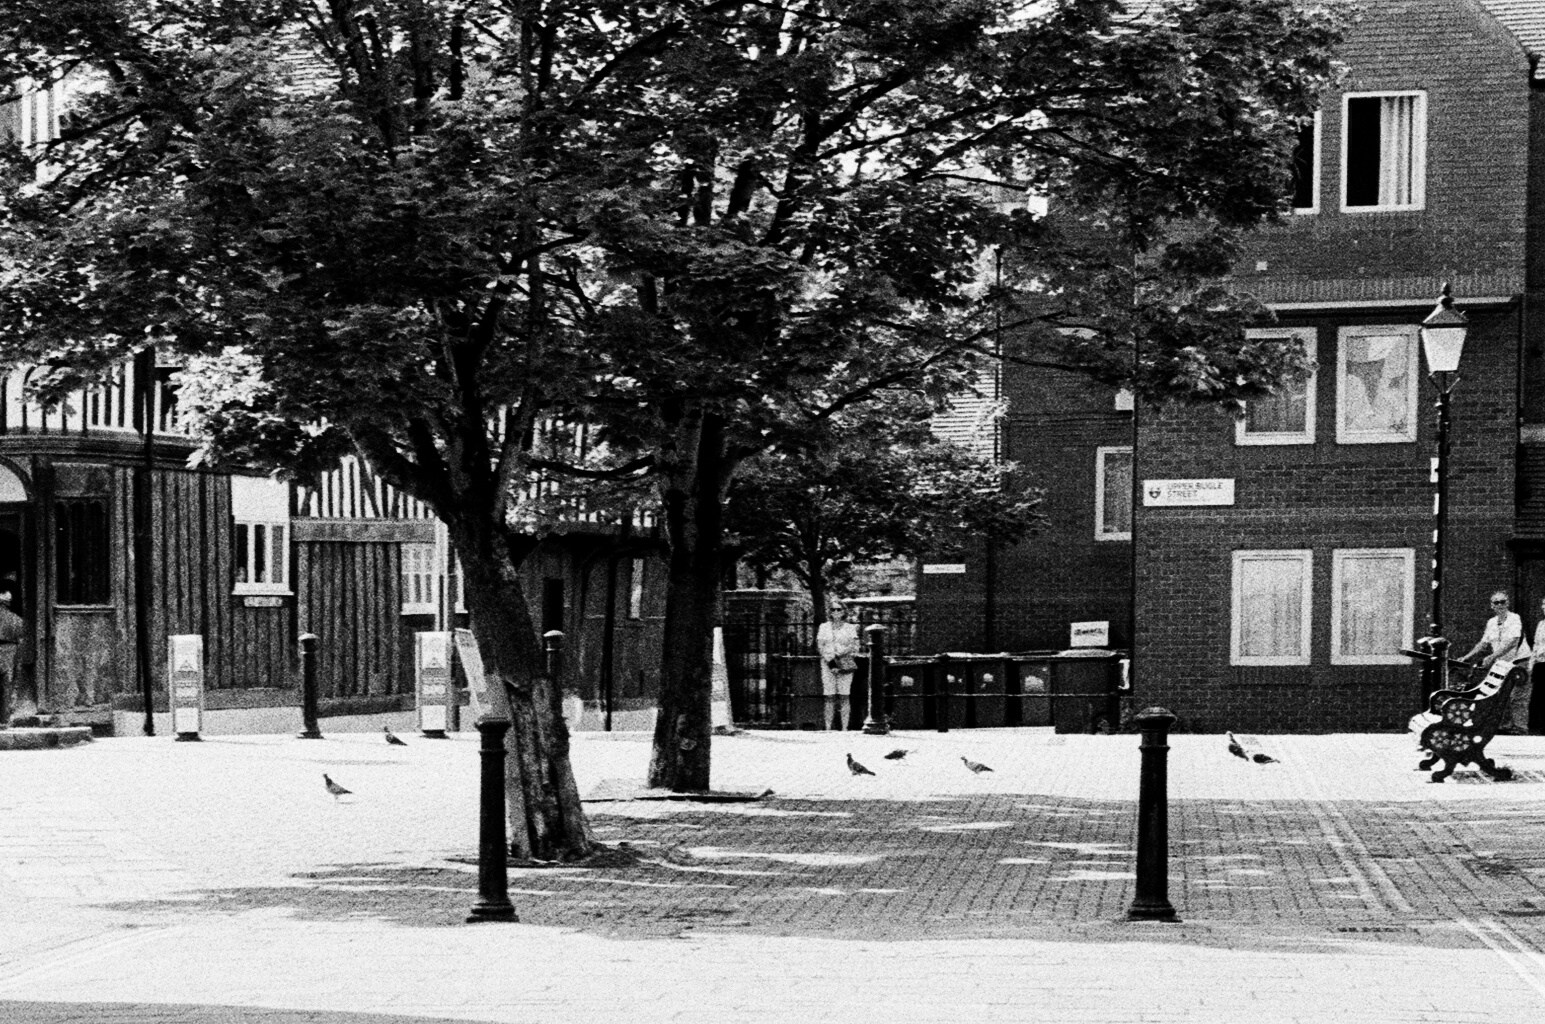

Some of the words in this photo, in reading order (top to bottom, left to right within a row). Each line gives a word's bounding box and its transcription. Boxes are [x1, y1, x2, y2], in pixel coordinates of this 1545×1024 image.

[1167, 482, 1194, 490] UPPER
[1195, 482, 1223, 490] BUGLE
[1167, 490, 1198, 498] STREET
